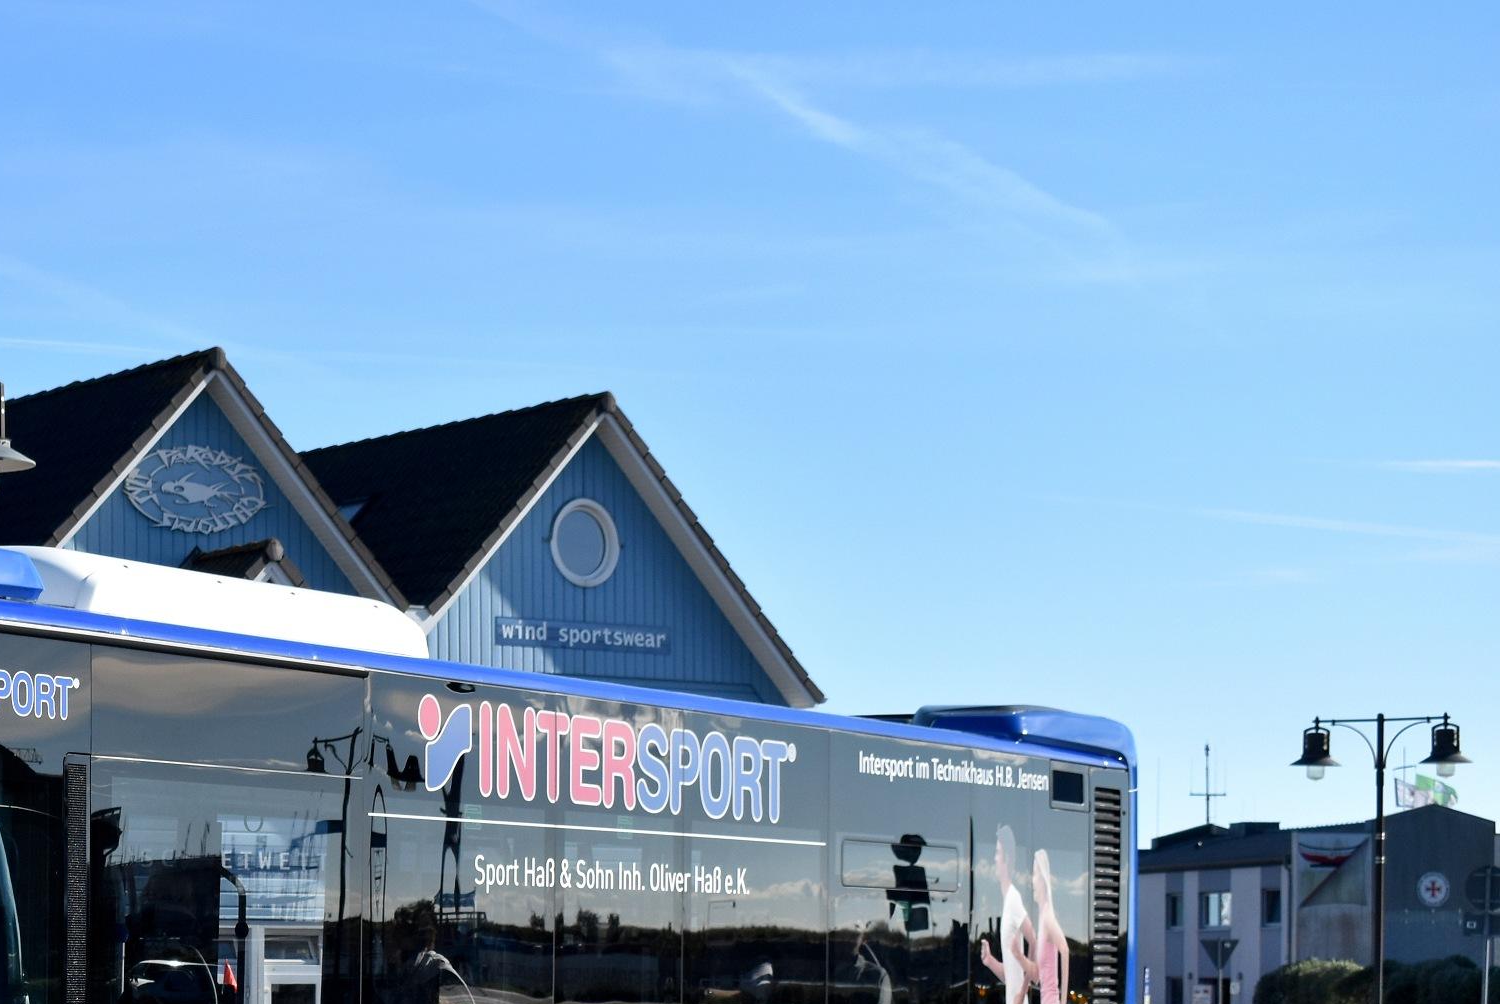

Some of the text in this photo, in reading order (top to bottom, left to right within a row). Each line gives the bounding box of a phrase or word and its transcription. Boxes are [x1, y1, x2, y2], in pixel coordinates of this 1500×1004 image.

[501, 619, 667, 648] wind sportswear
[478, 700, 789, 825] INTERSPORT
[858, 750, 1049, 792] Intersport im Technikhaus H.B. Jensen
[474, 854, 750, 896] Sport Haß & Sohn Inh. Oliver Haß e.K.
